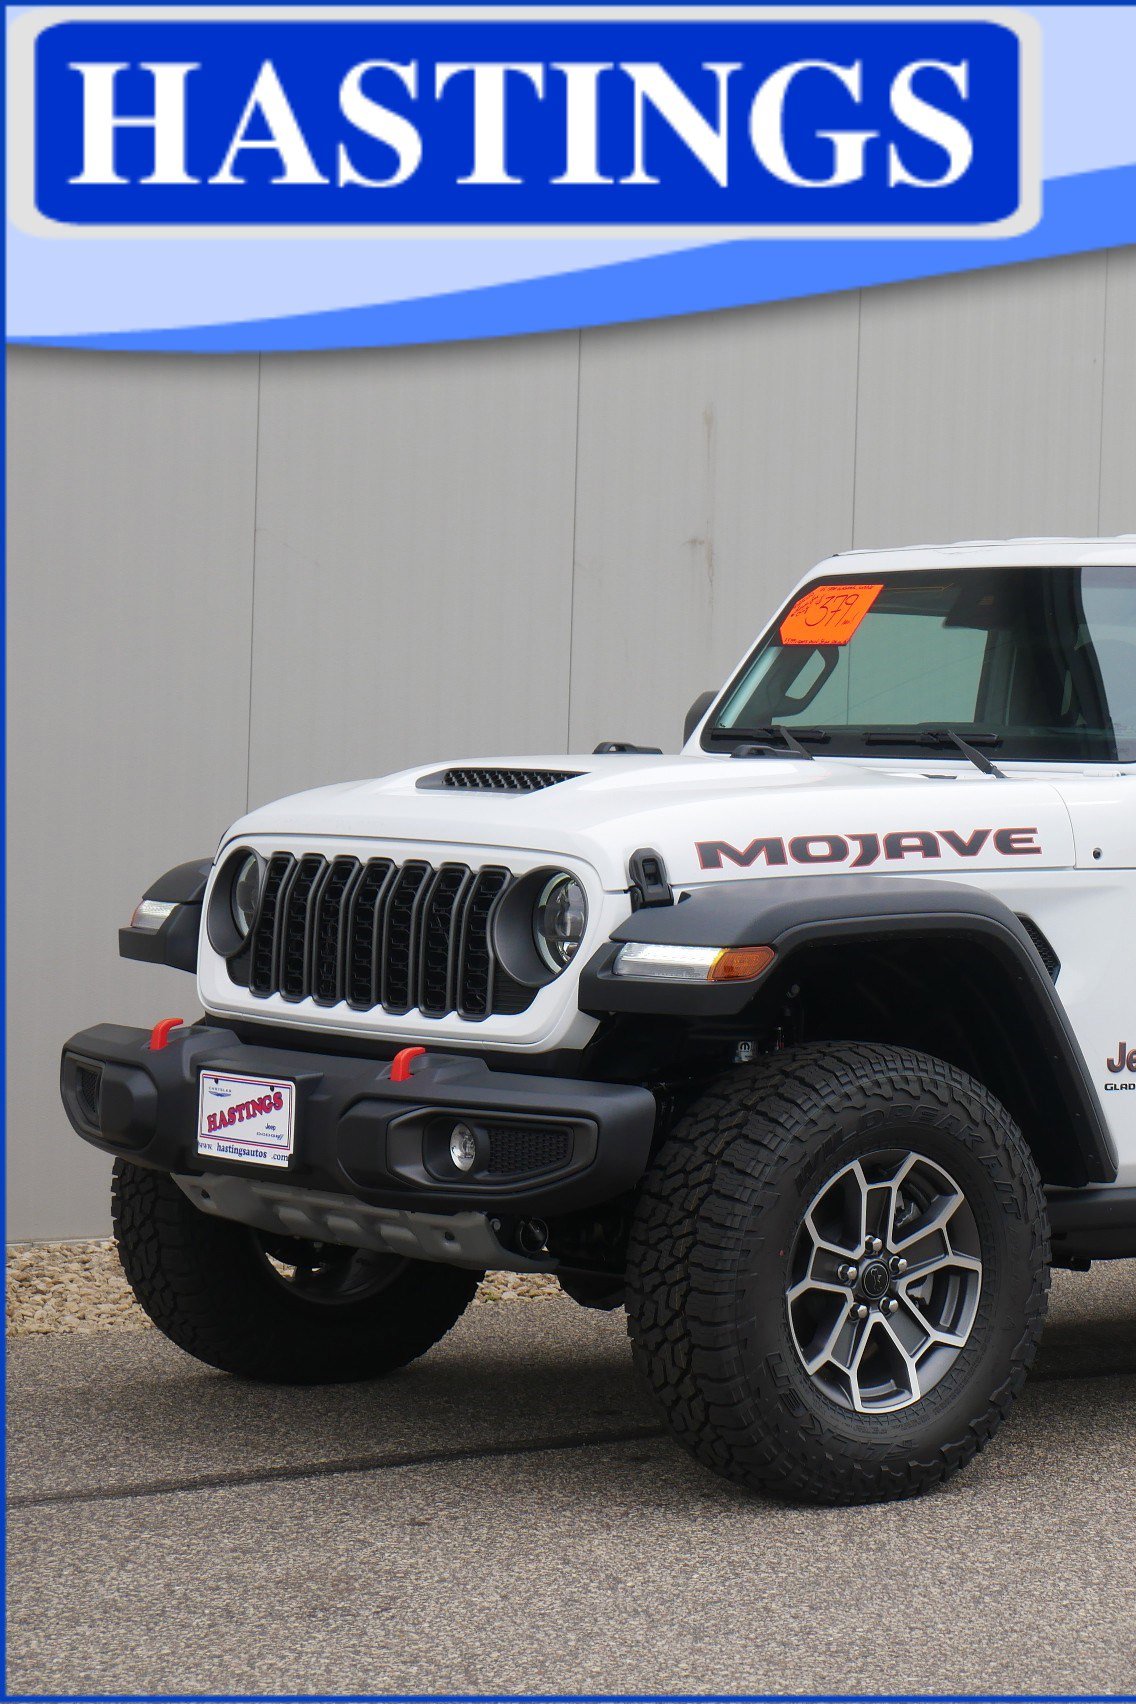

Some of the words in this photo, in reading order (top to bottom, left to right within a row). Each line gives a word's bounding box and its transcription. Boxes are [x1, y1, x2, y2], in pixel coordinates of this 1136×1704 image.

[694, 827, 1043, 870] MOJAVE
[206, 1091, 284, 1133] HASTINGS
[216, 1143, 268, 1158] hastingsautos
